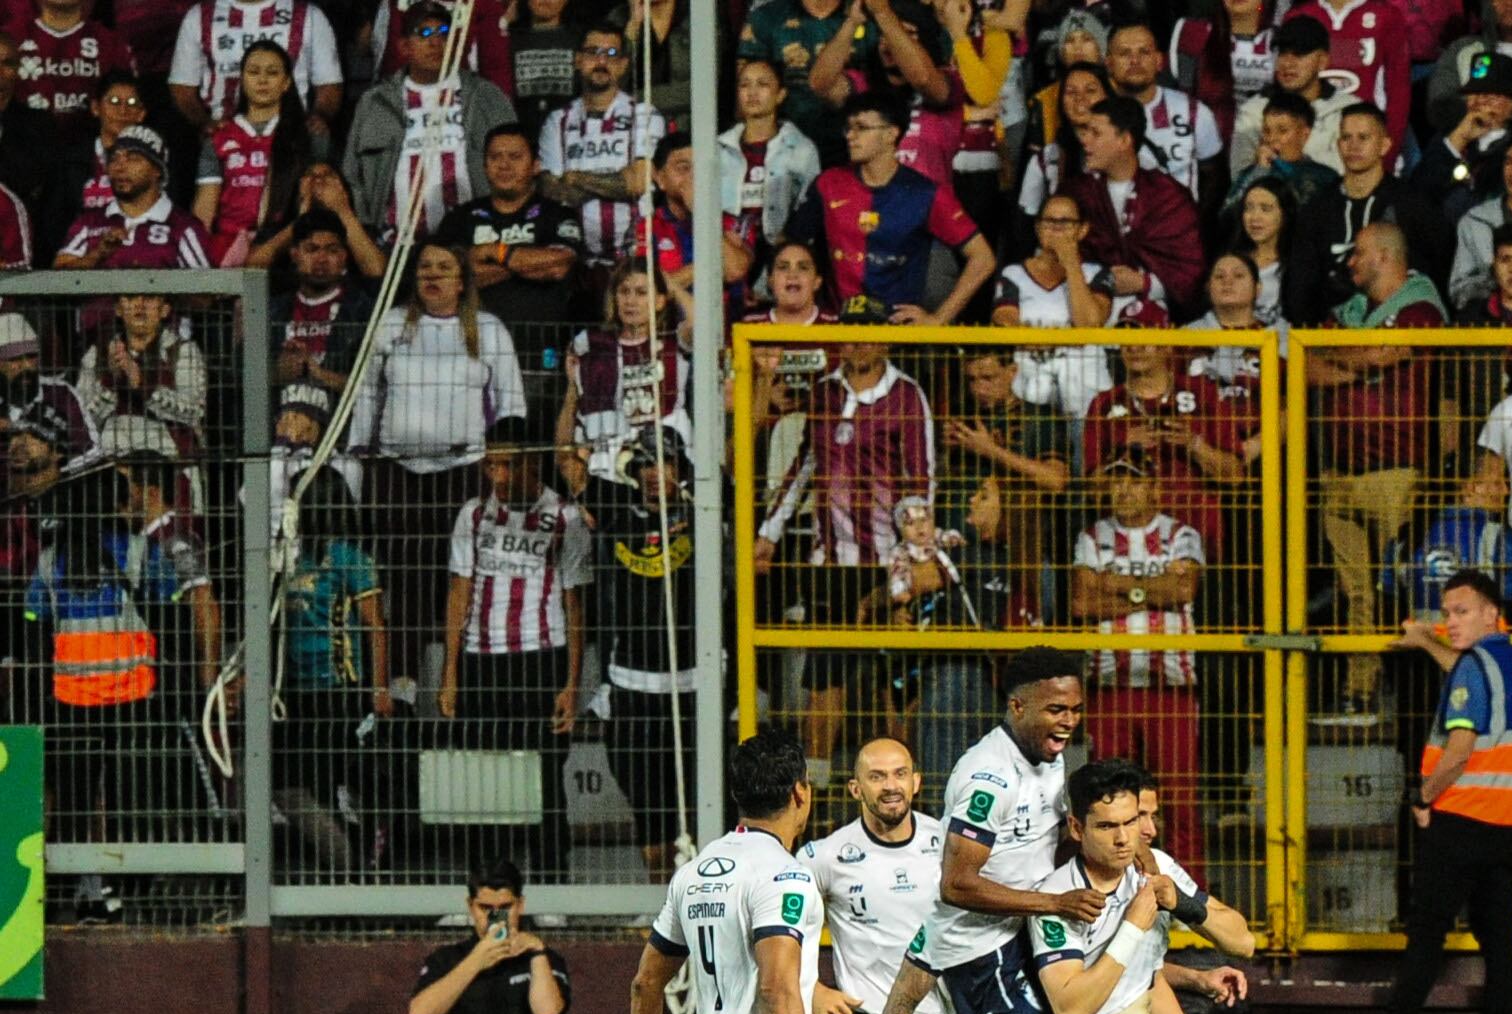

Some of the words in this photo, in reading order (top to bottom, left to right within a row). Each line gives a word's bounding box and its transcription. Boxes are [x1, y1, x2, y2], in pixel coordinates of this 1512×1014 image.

[80, 37, 100, 59] S
[1172, 114, 1191, 137] S
[584, 139, 627, 159] BAC
[1177, 391, 1197, 413] S
[538, 512, 556, 533] S
[501, 533, 545, 557] BAC
[573, 770, 602, 795] 10
[1343, 774, 1372, 798] 16
[686, 882, 736, 896] CHERY
[687, 901, 727, 921] ESPINOZA
